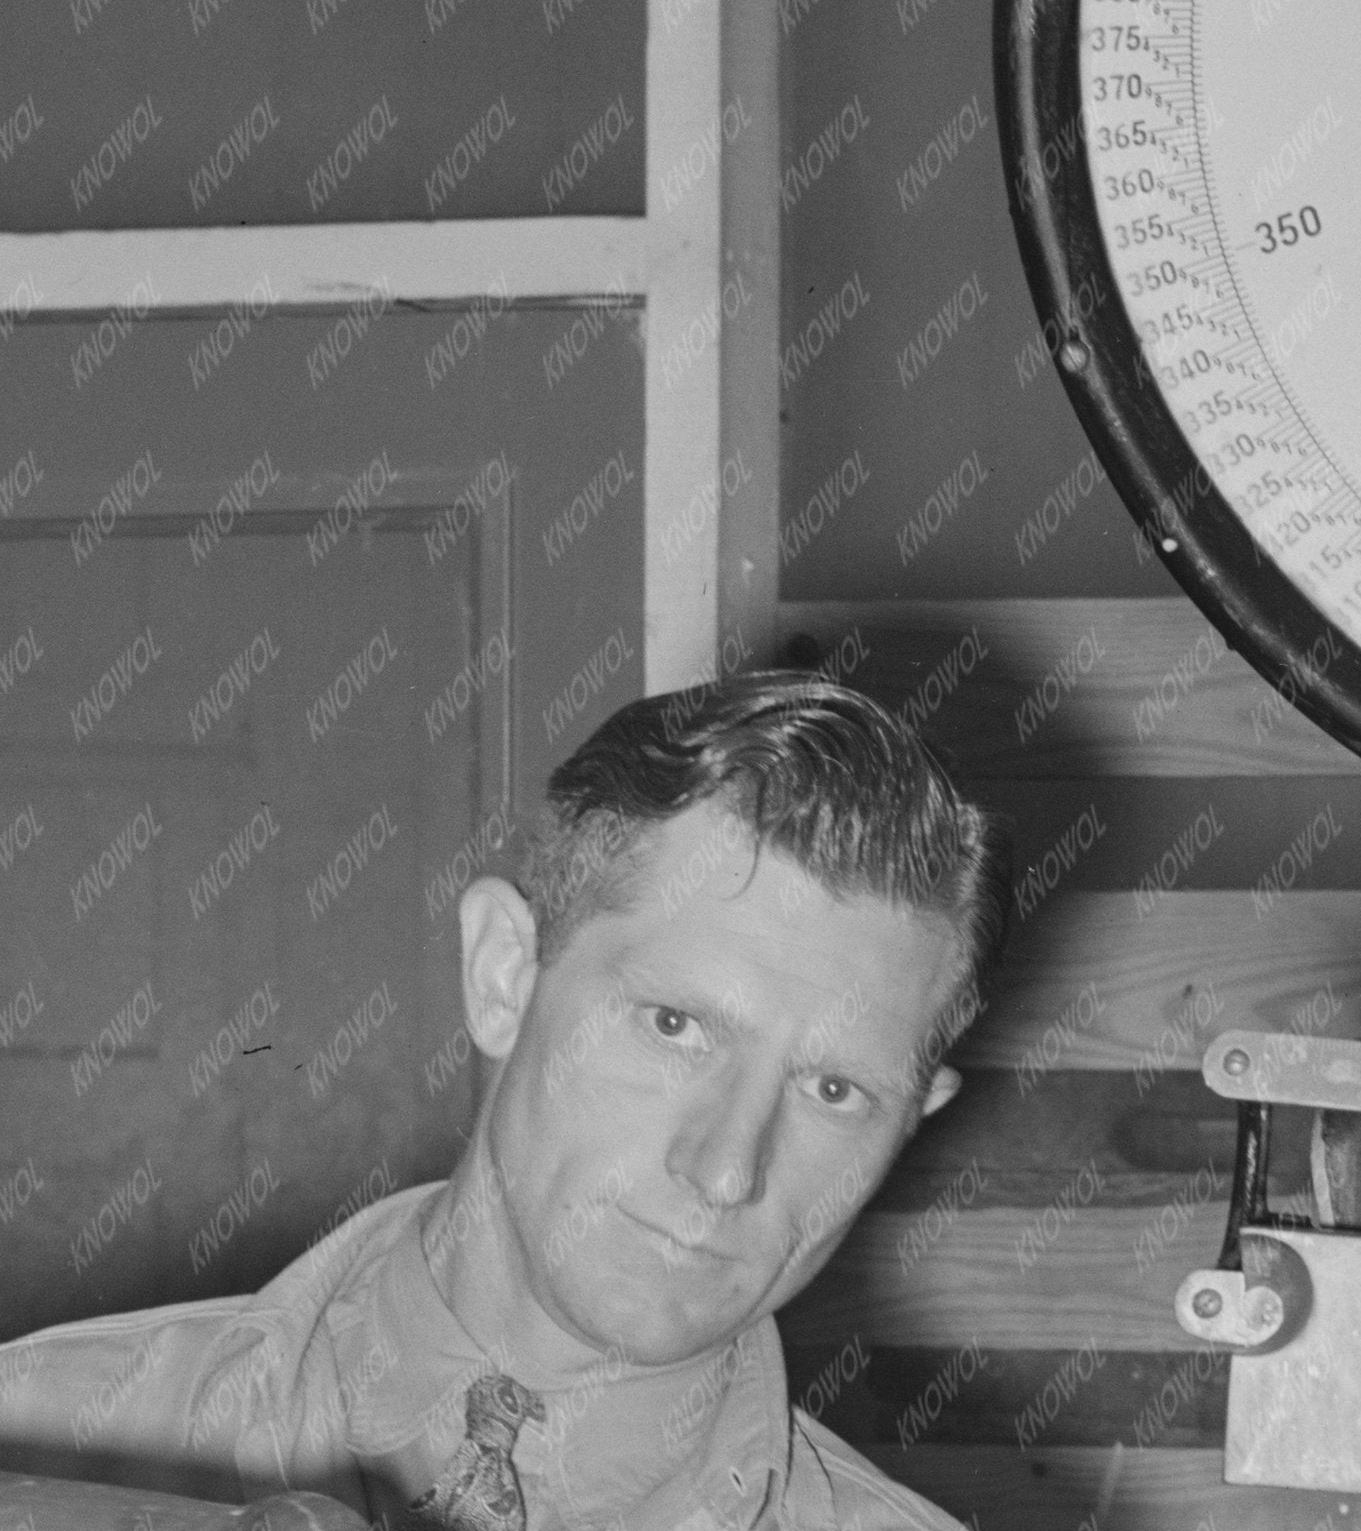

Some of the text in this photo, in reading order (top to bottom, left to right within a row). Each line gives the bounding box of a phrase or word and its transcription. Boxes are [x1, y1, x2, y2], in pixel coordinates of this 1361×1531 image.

[1091, 26, 1140, 52] 375
[1093, 74, 1142, 102] 370
[1097, 120, 1147, 151] 365
[1104, 169, 1155, 201] 360
[1115, 214, 1164, 250] 355
[1255, 205, 1322, 254] 350
[1128, 260, 1177, 298] 350
[1309, 544, 1342, 580] 15
